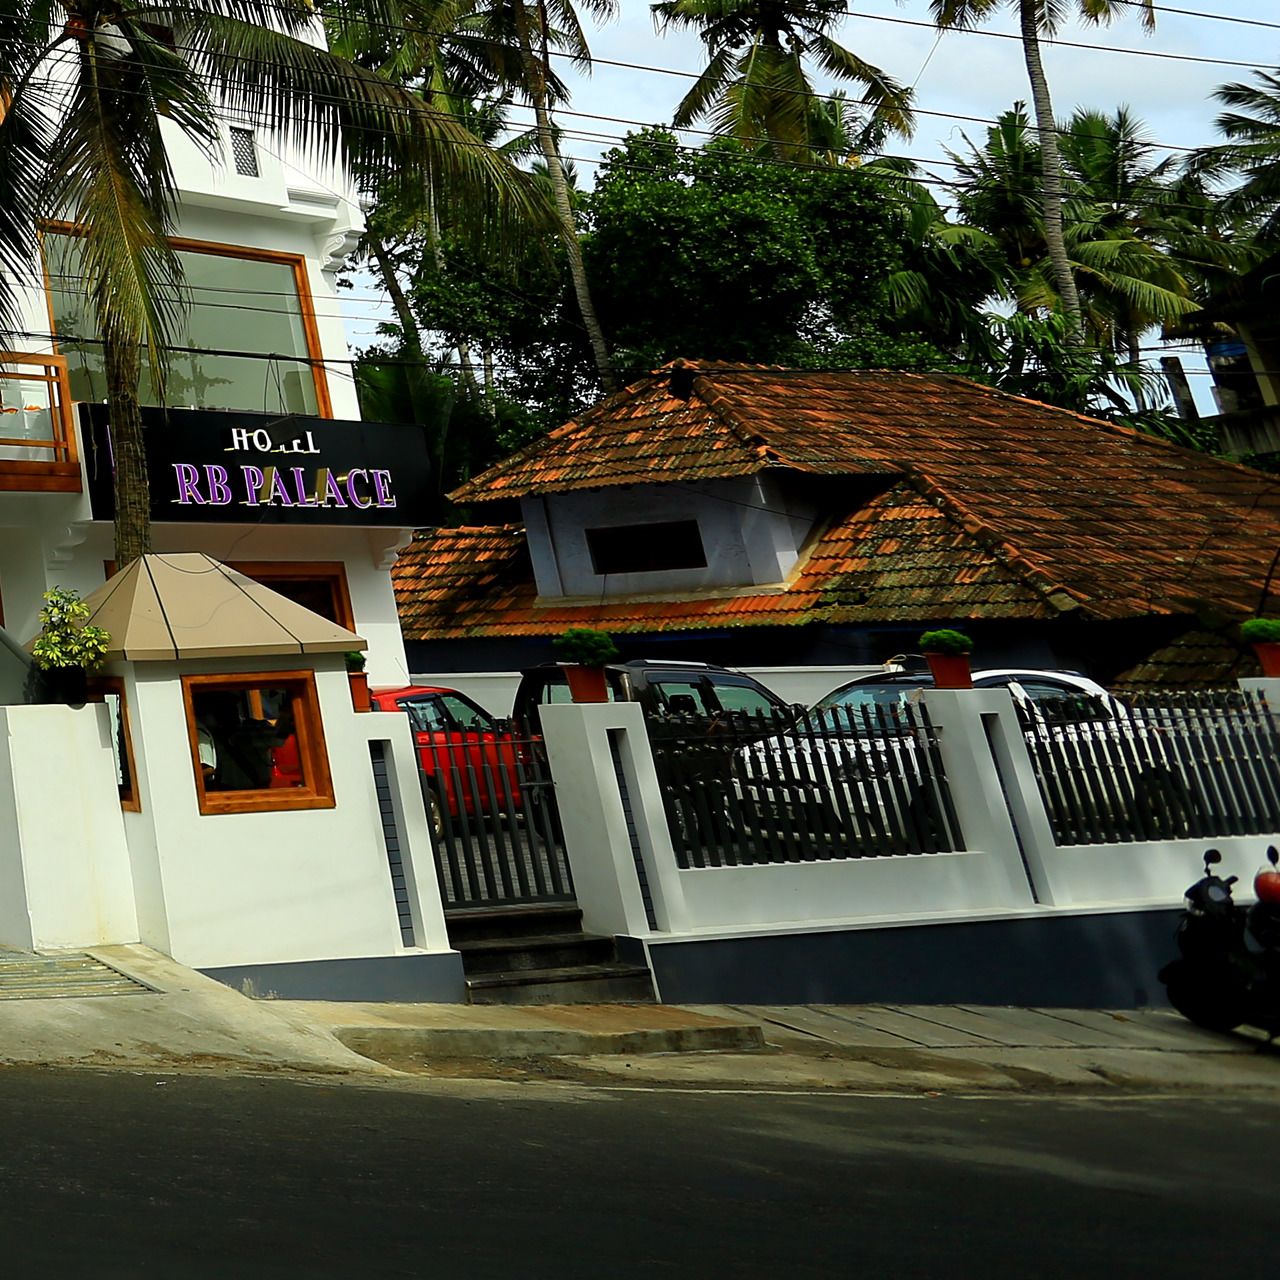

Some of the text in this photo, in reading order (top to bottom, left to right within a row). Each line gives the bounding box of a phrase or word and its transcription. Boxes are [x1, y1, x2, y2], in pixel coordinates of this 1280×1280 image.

[231, 427, 321, 454] HOEL
[171, 463, 397, 509] RB PALACE
